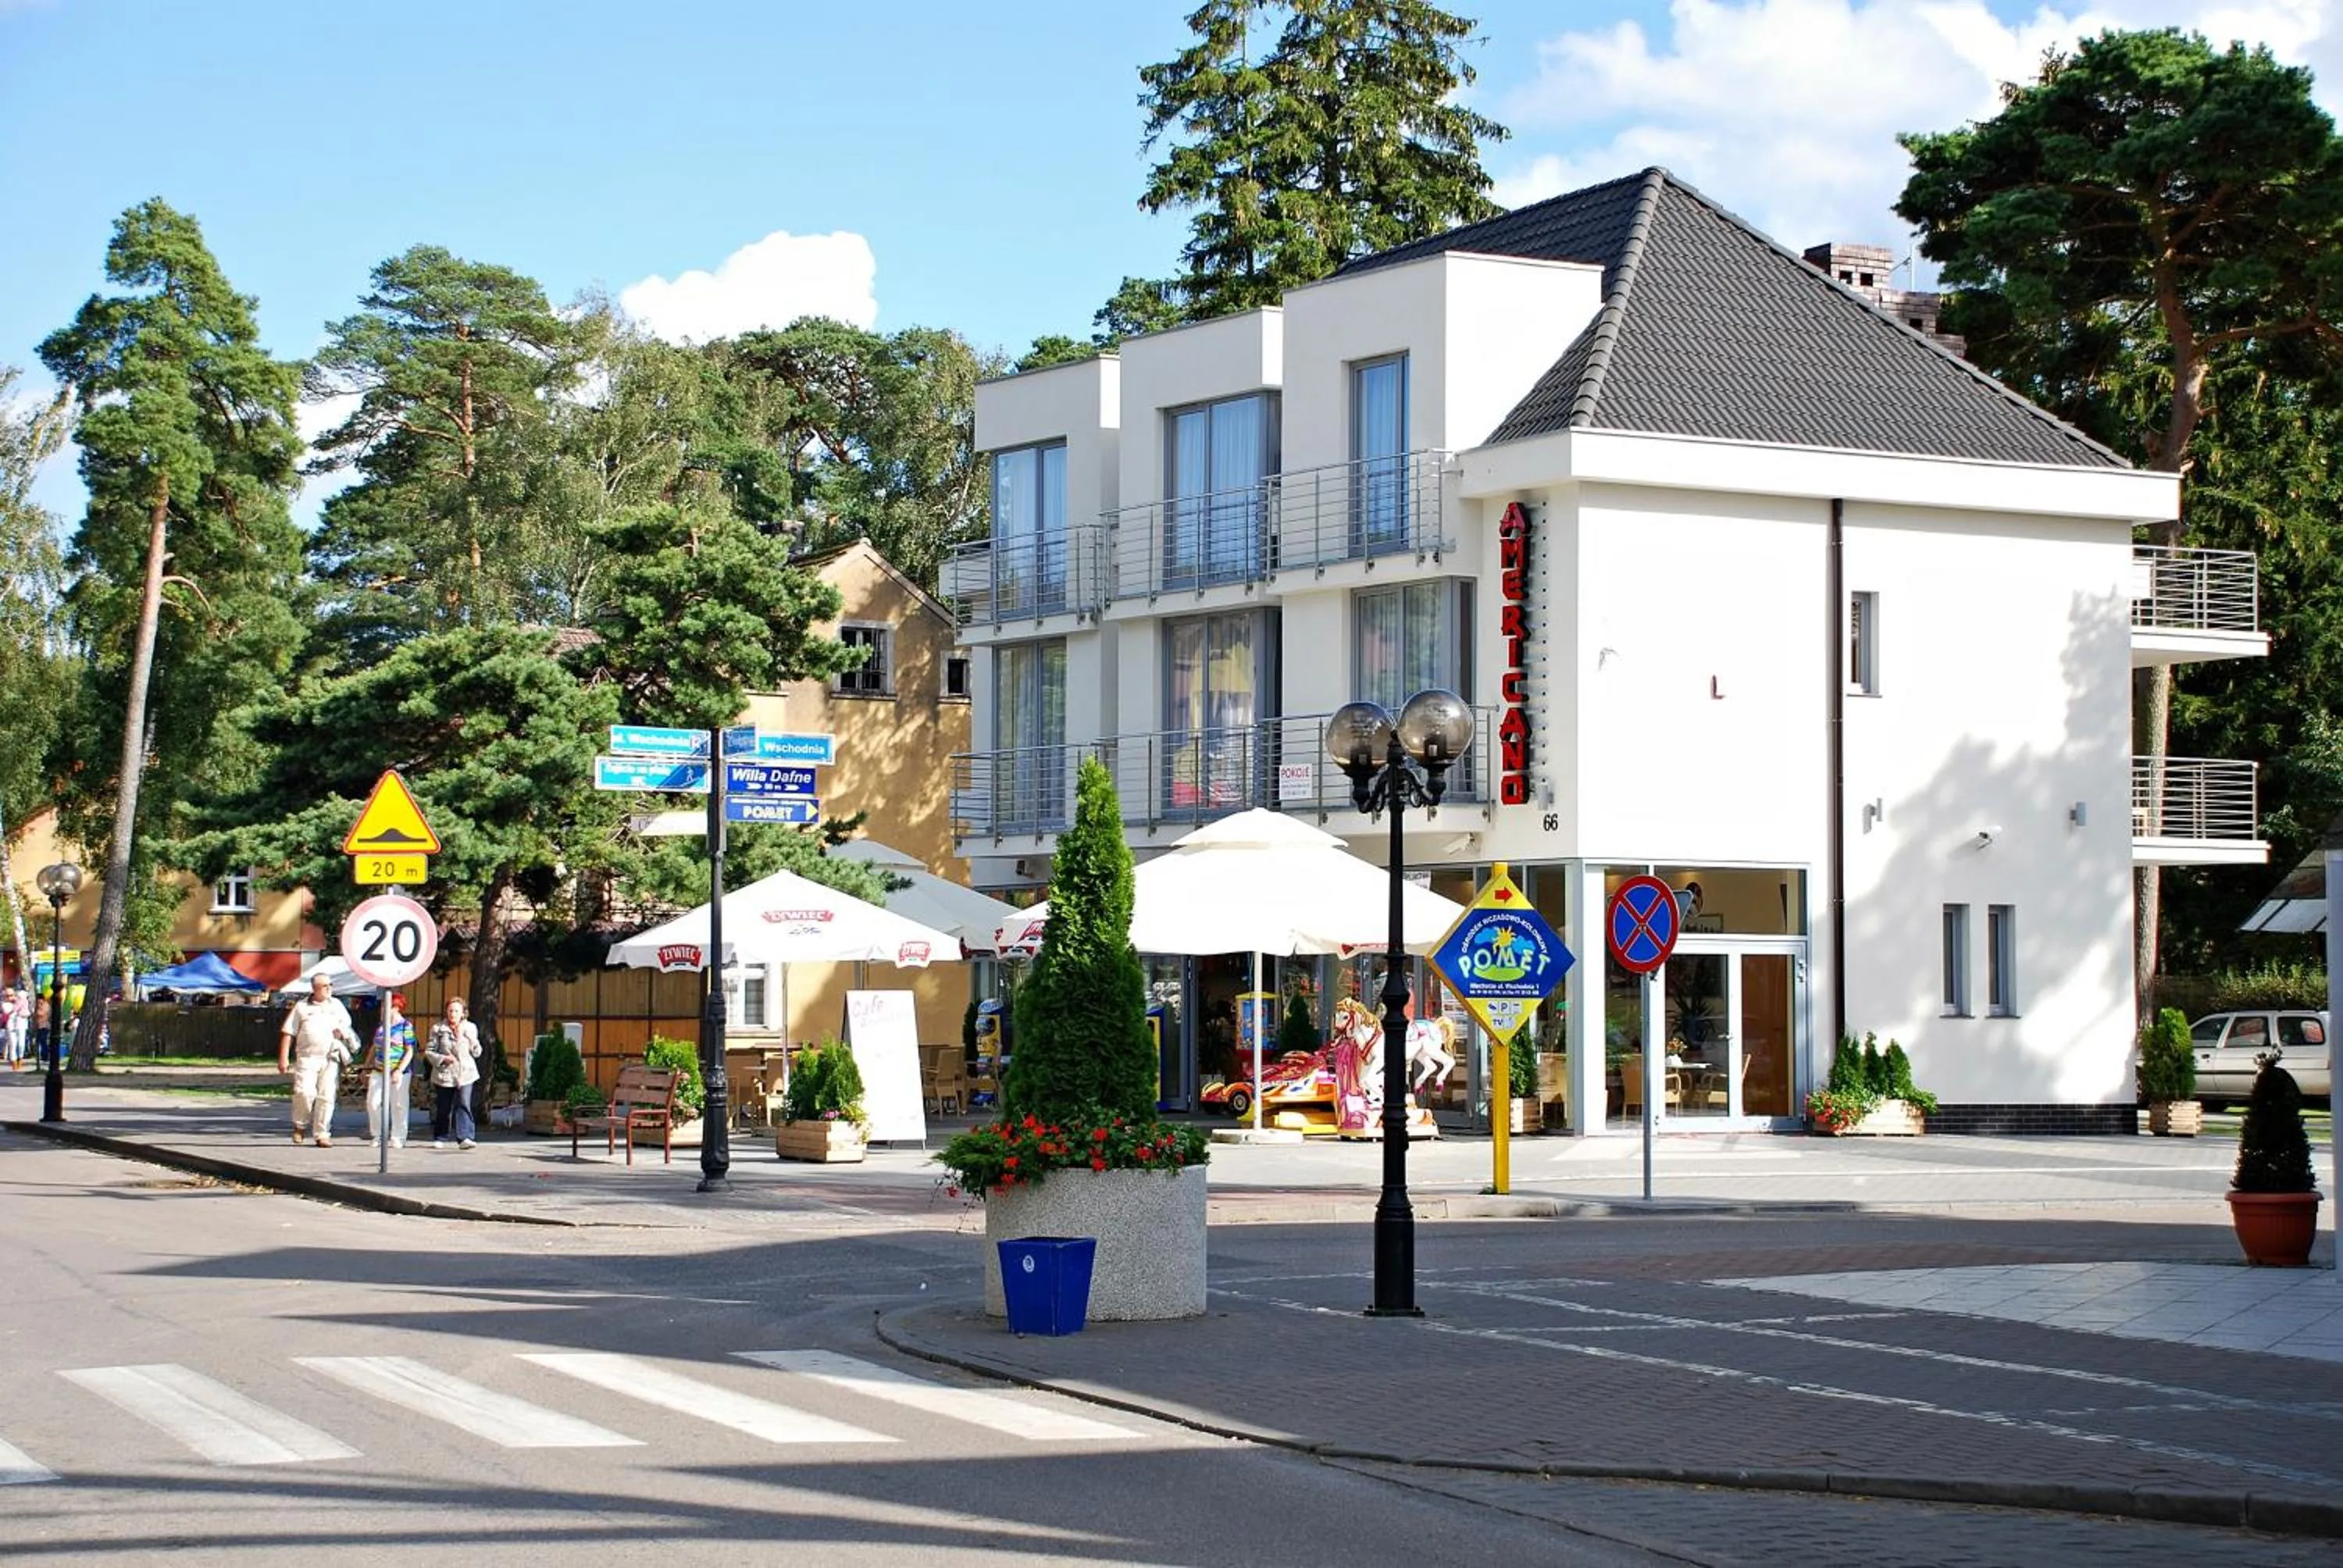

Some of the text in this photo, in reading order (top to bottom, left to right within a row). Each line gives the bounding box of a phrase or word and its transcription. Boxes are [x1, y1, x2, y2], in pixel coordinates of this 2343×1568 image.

[1500, 502, 1529, 804] AMERICANO
[765, 743, 826, 754] Wschodnia
[733, 768, 811, 783] Willa Dafne
[1543, 813, 1558, 831] 66
[373, 862, 418, 877] 20 m
[361, 920, 422, 963] 20
[1458, 947, 1551, 978] POMET
